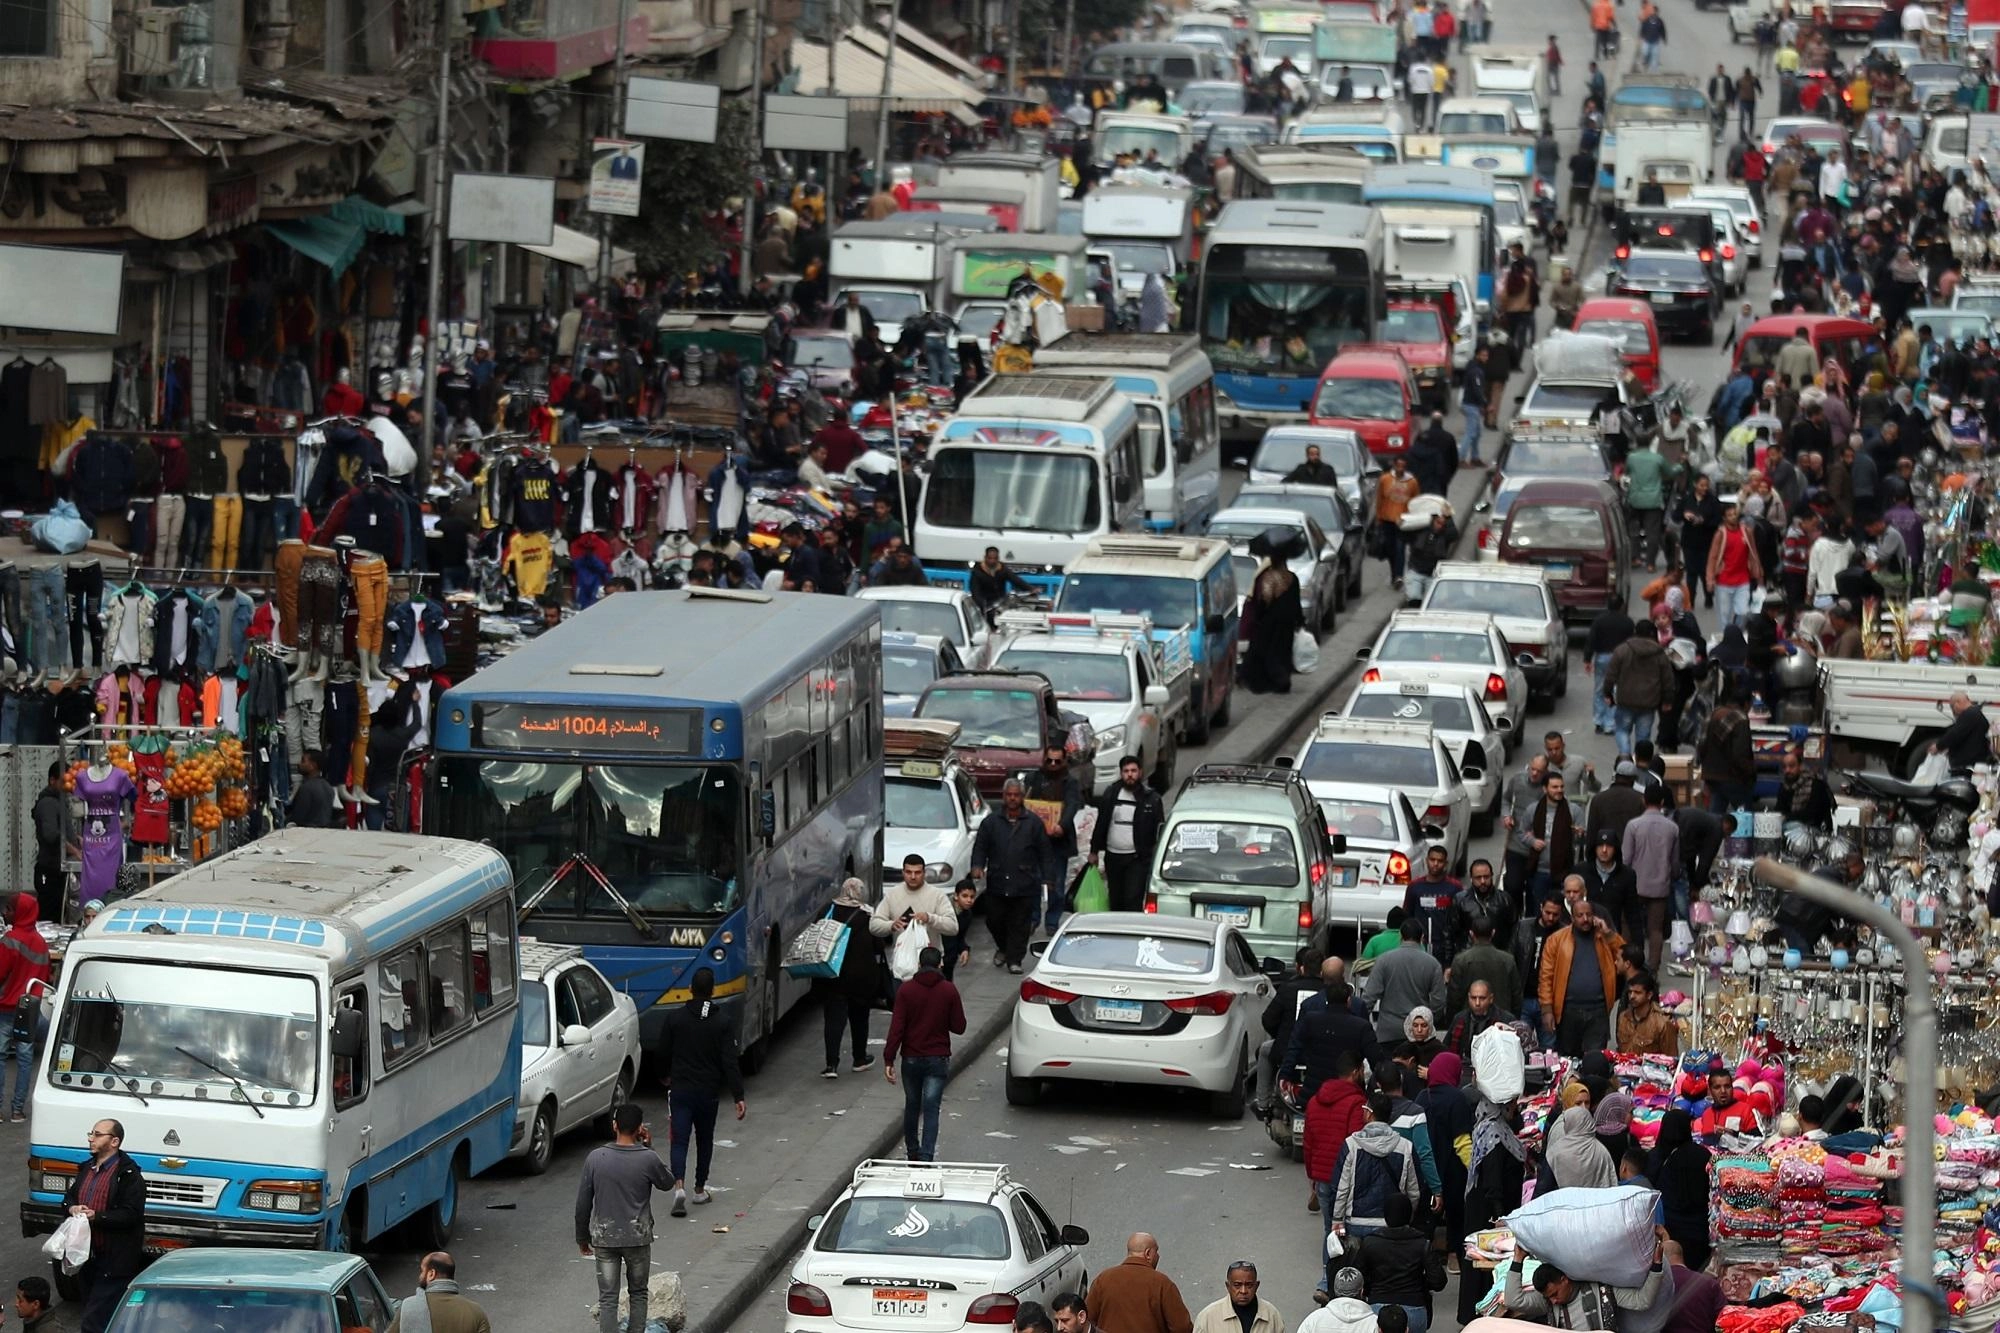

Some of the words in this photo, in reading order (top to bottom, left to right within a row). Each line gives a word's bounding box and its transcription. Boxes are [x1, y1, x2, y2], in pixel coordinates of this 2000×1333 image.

[562, 716, 607, 735] 1004
[670, 927, 706, 946] ٨٥٣٨
[910, 1182, 936, 1193] TAXI
[916, 1279, 940, 1289] ربنا
